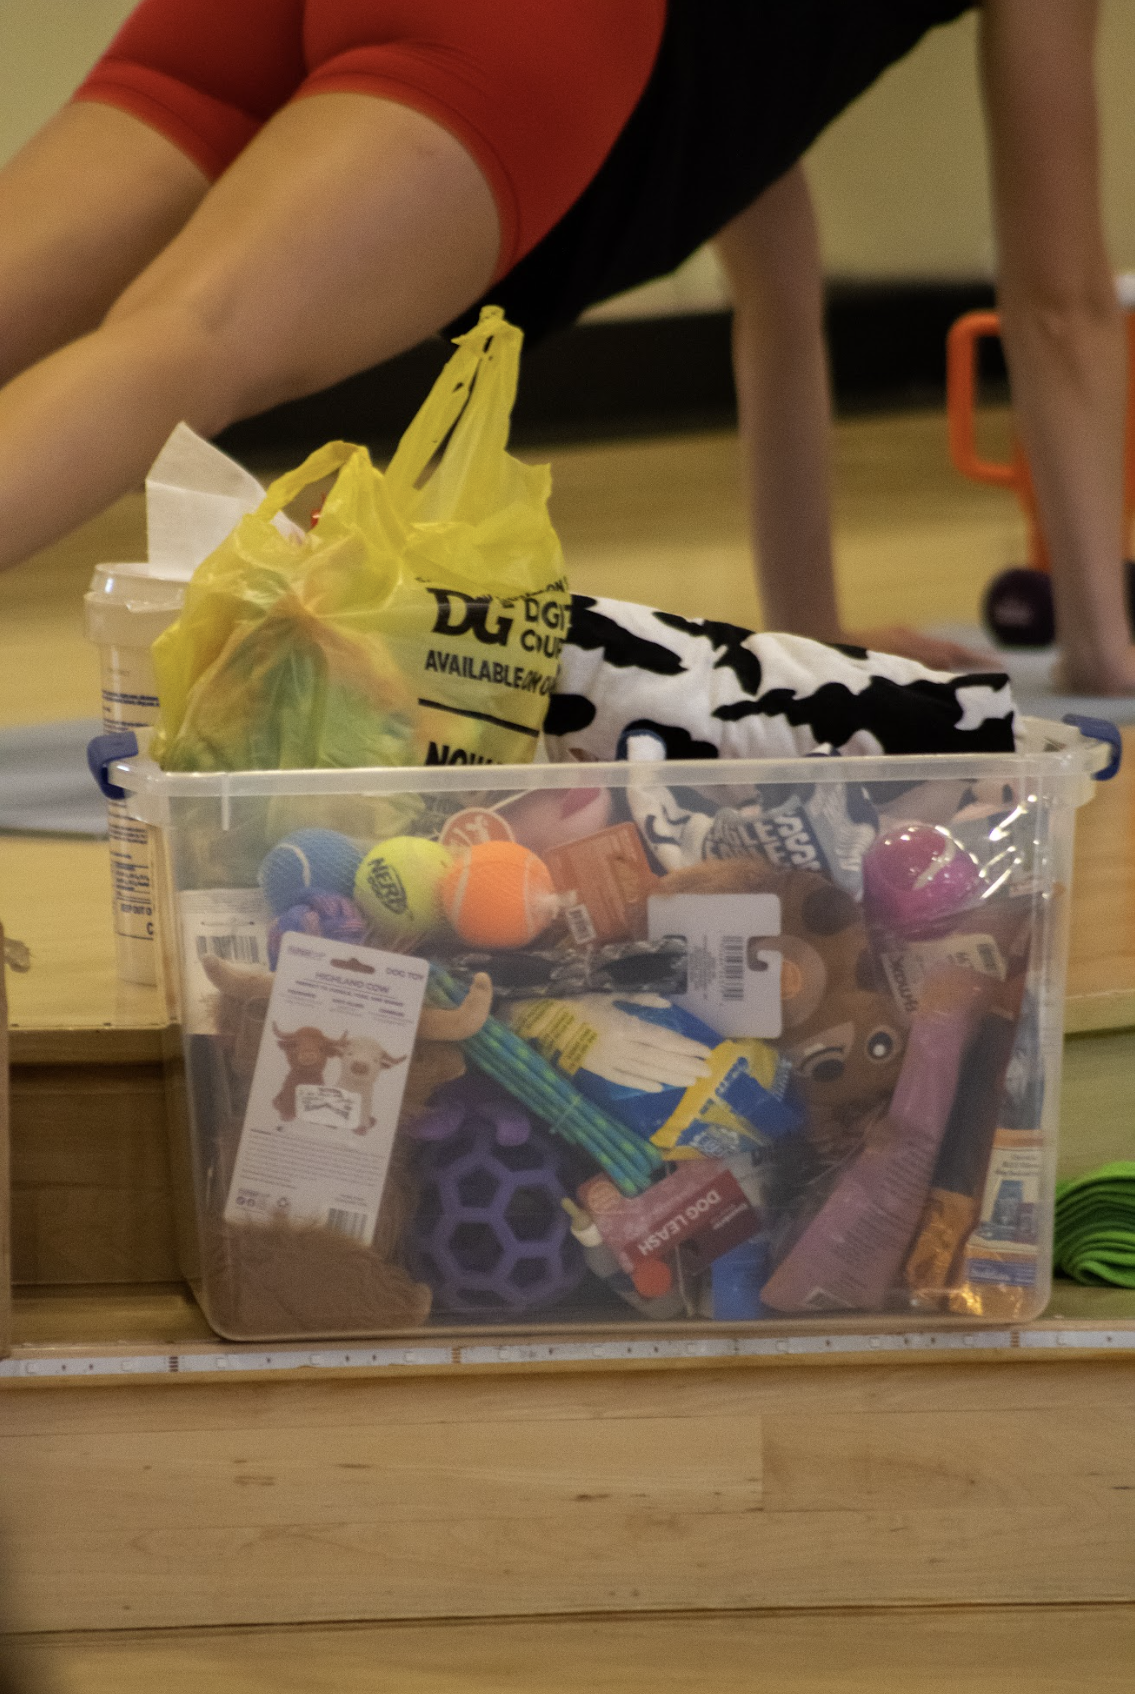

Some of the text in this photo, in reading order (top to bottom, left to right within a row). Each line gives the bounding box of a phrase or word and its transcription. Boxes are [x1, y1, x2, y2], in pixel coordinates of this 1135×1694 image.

[426, 587, 514, 646] DG
[425, 650, 524, 689] AVAILABLE
[685, 1189, 721, 1220] DOG
[637, 1214, 689, 1256] LEASH
